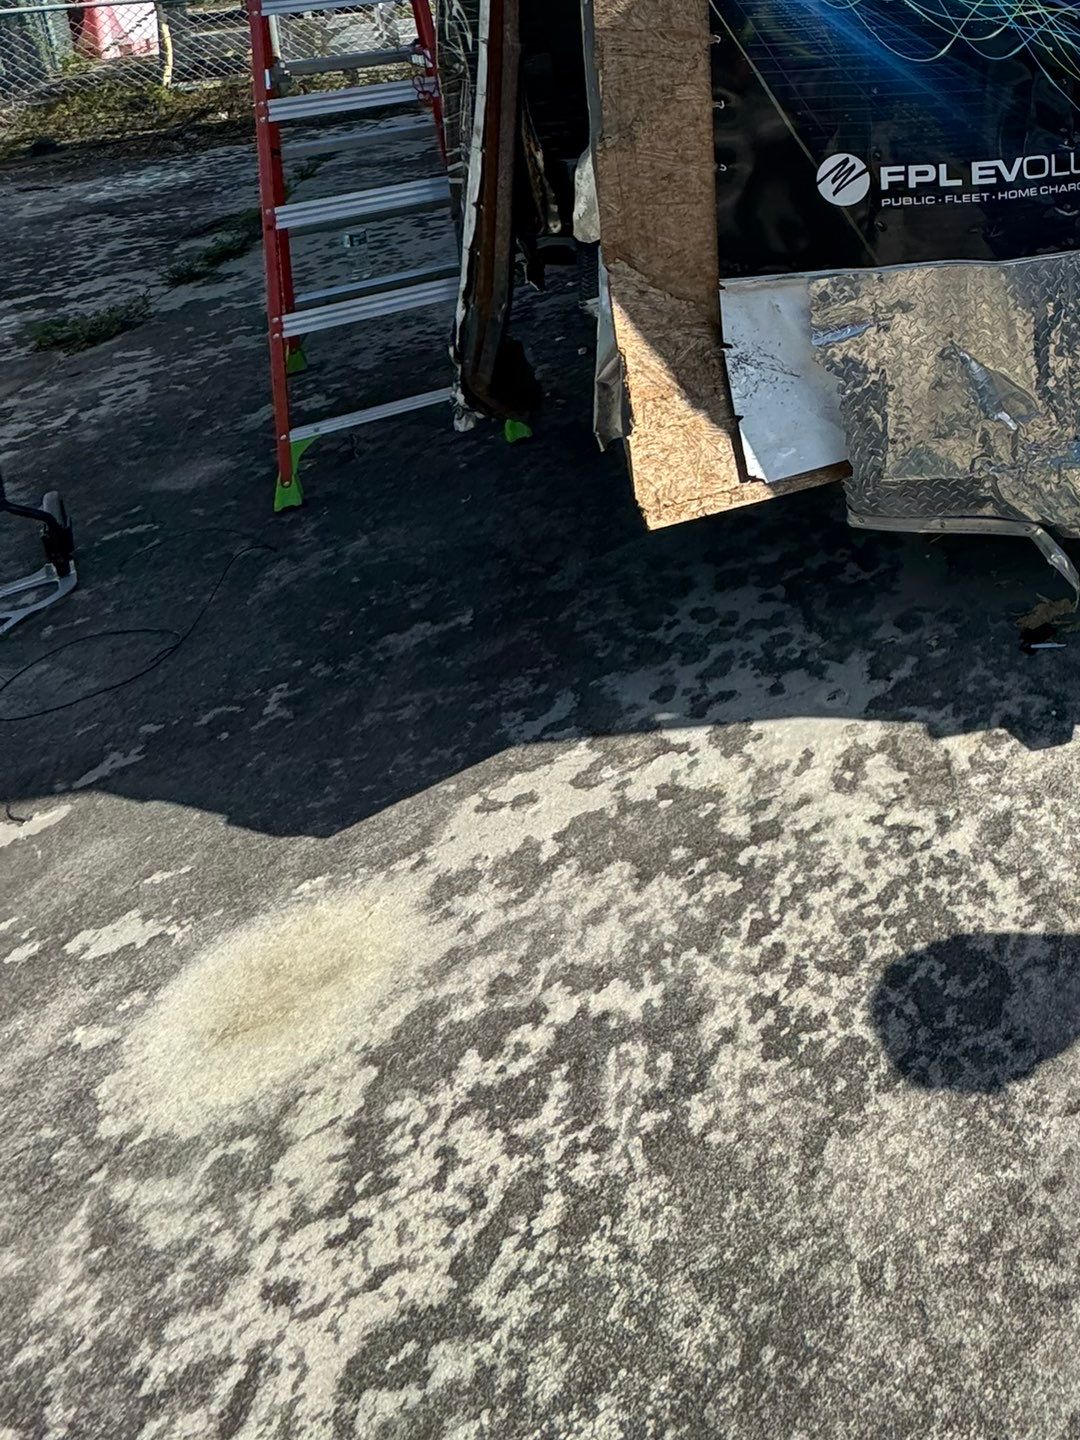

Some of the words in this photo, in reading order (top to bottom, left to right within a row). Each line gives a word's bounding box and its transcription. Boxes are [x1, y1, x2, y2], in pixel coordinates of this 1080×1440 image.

[880, 164, 963, 191] FPL
[881, 197, 936, 207] PUBLIC
[944, 192, 991, 205] FLEET
[998, 186, 1038, 201] HOME
